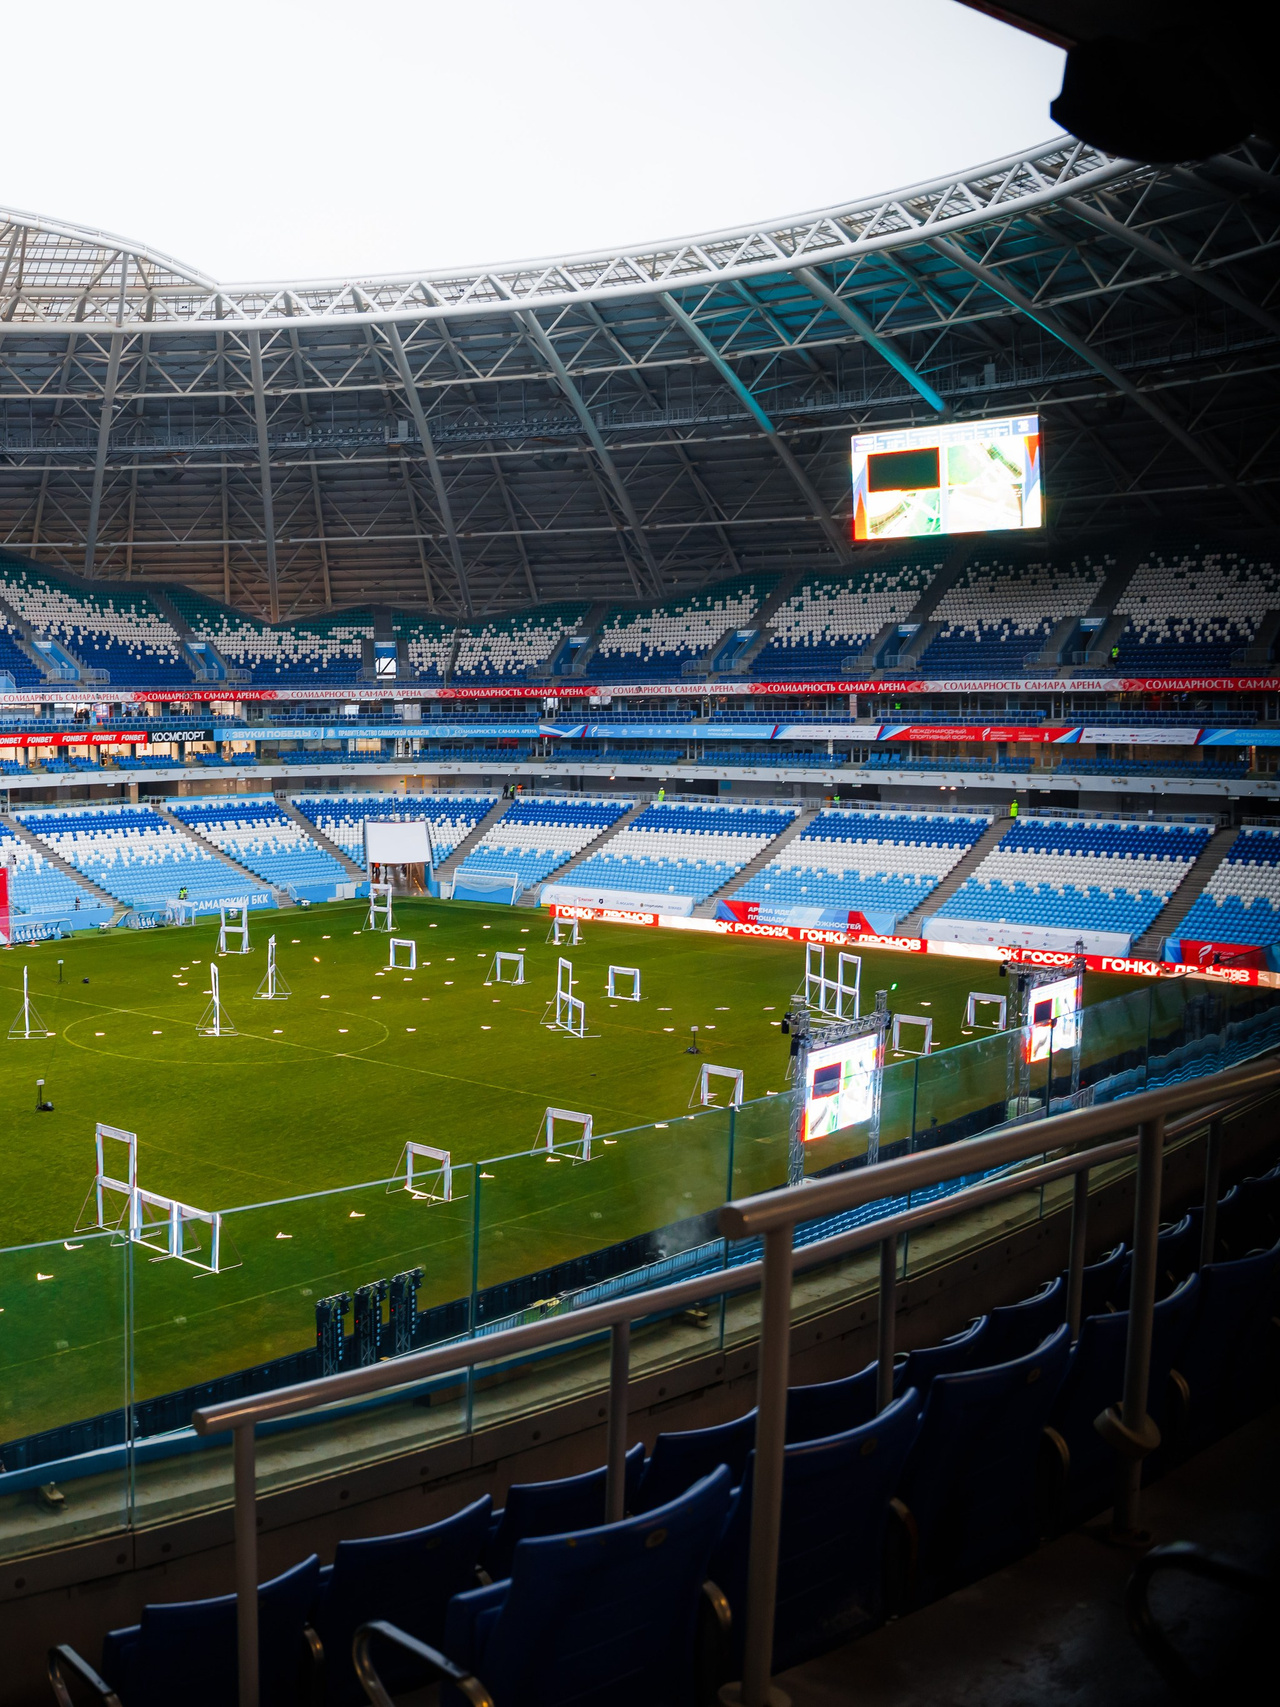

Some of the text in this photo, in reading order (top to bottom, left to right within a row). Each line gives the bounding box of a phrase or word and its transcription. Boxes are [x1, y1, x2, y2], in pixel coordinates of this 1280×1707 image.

[767, 683, 906, 693] СОЛИДАРНОСТЬ САМАРА АРЕНА
[943, 680, 1102, 691] СОЛИДАРНОСТЬ САМАРА АРЕНА
[1145, 679, 1280, 690] СОЛИДАРНОСТЬ САМАР
[524, 688, 557, 696] САМАРА
[674, 685, 707, 694] САМАРА
[709, 685, 734, 693] АРЕНА
[65, 693, 95, 702] САМАРА
[203, 692, 234, 700] САМАРА
[291, 690, 356, 699] СОЛИДАРНОСТЬ
[359, 690, 394, 698] САМАРА
[232, 730, 311, 739] ЗВУКИ ПОБЕДЫ
[251, 893, 269, 905] БКК
[747, 906, 773, 915] АРЕНА
